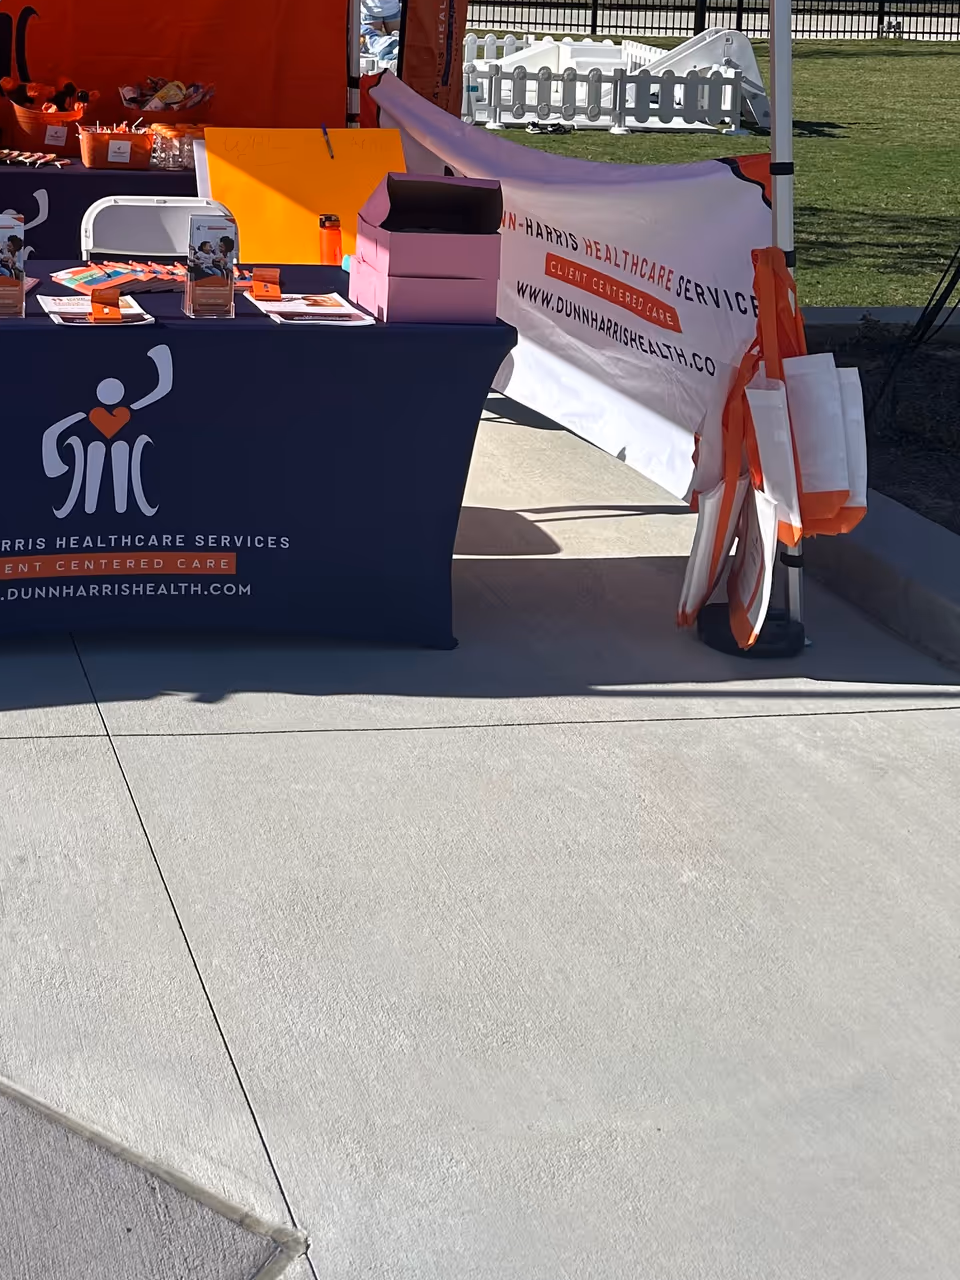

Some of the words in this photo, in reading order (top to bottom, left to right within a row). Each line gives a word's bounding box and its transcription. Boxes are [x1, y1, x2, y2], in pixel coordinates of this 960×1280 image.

[501, 210, 579, 251] NN-HARRIS
[583, 237, 674, 292] HEALTHCARE
[676, 275, 758, 318] SERVICE
[550, 261, 587, 284] CLIENT
[592, 277, 643, 310] CENTERED
[646, 304, 674, 326] CARE
[516, 280, 716, 377] WWW.DUNNHARRISHEALTH.CO
[56, 534, 185, 549] HEALTHCARE
[194, 534, 290, 549] SERVICES
[56, 558, 164, 571] CENTERED
[177, 557, 230, 570] CARE
